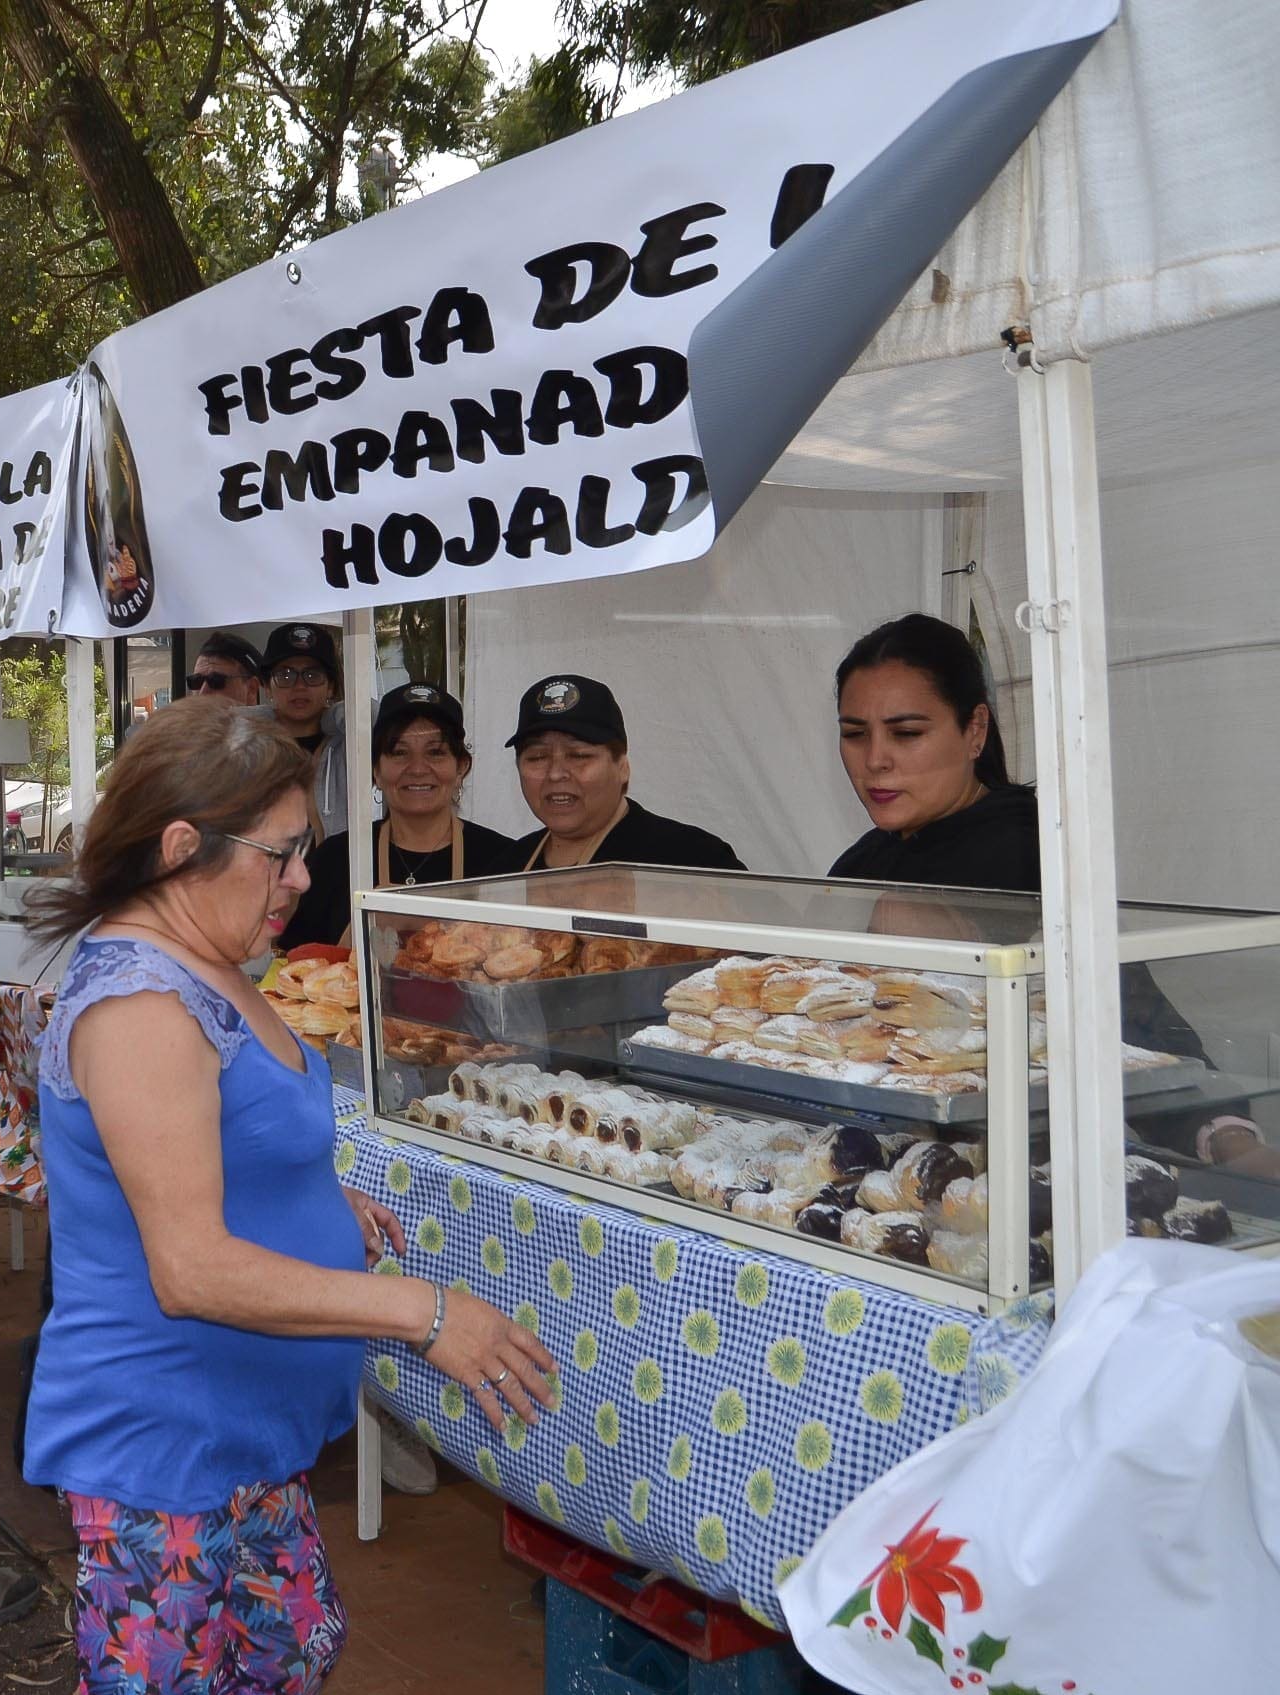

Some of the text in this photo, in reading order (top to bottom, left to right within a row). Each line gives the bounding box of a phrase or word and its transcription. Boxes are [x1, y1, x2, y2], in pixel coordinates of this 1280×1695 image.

[198, 286, 495, 436] FIESTA
[524, 202, 727, 330] DE
[219, 345, 690, 522] EMPANAD
[321, 454, 712, 589] HOJALD
